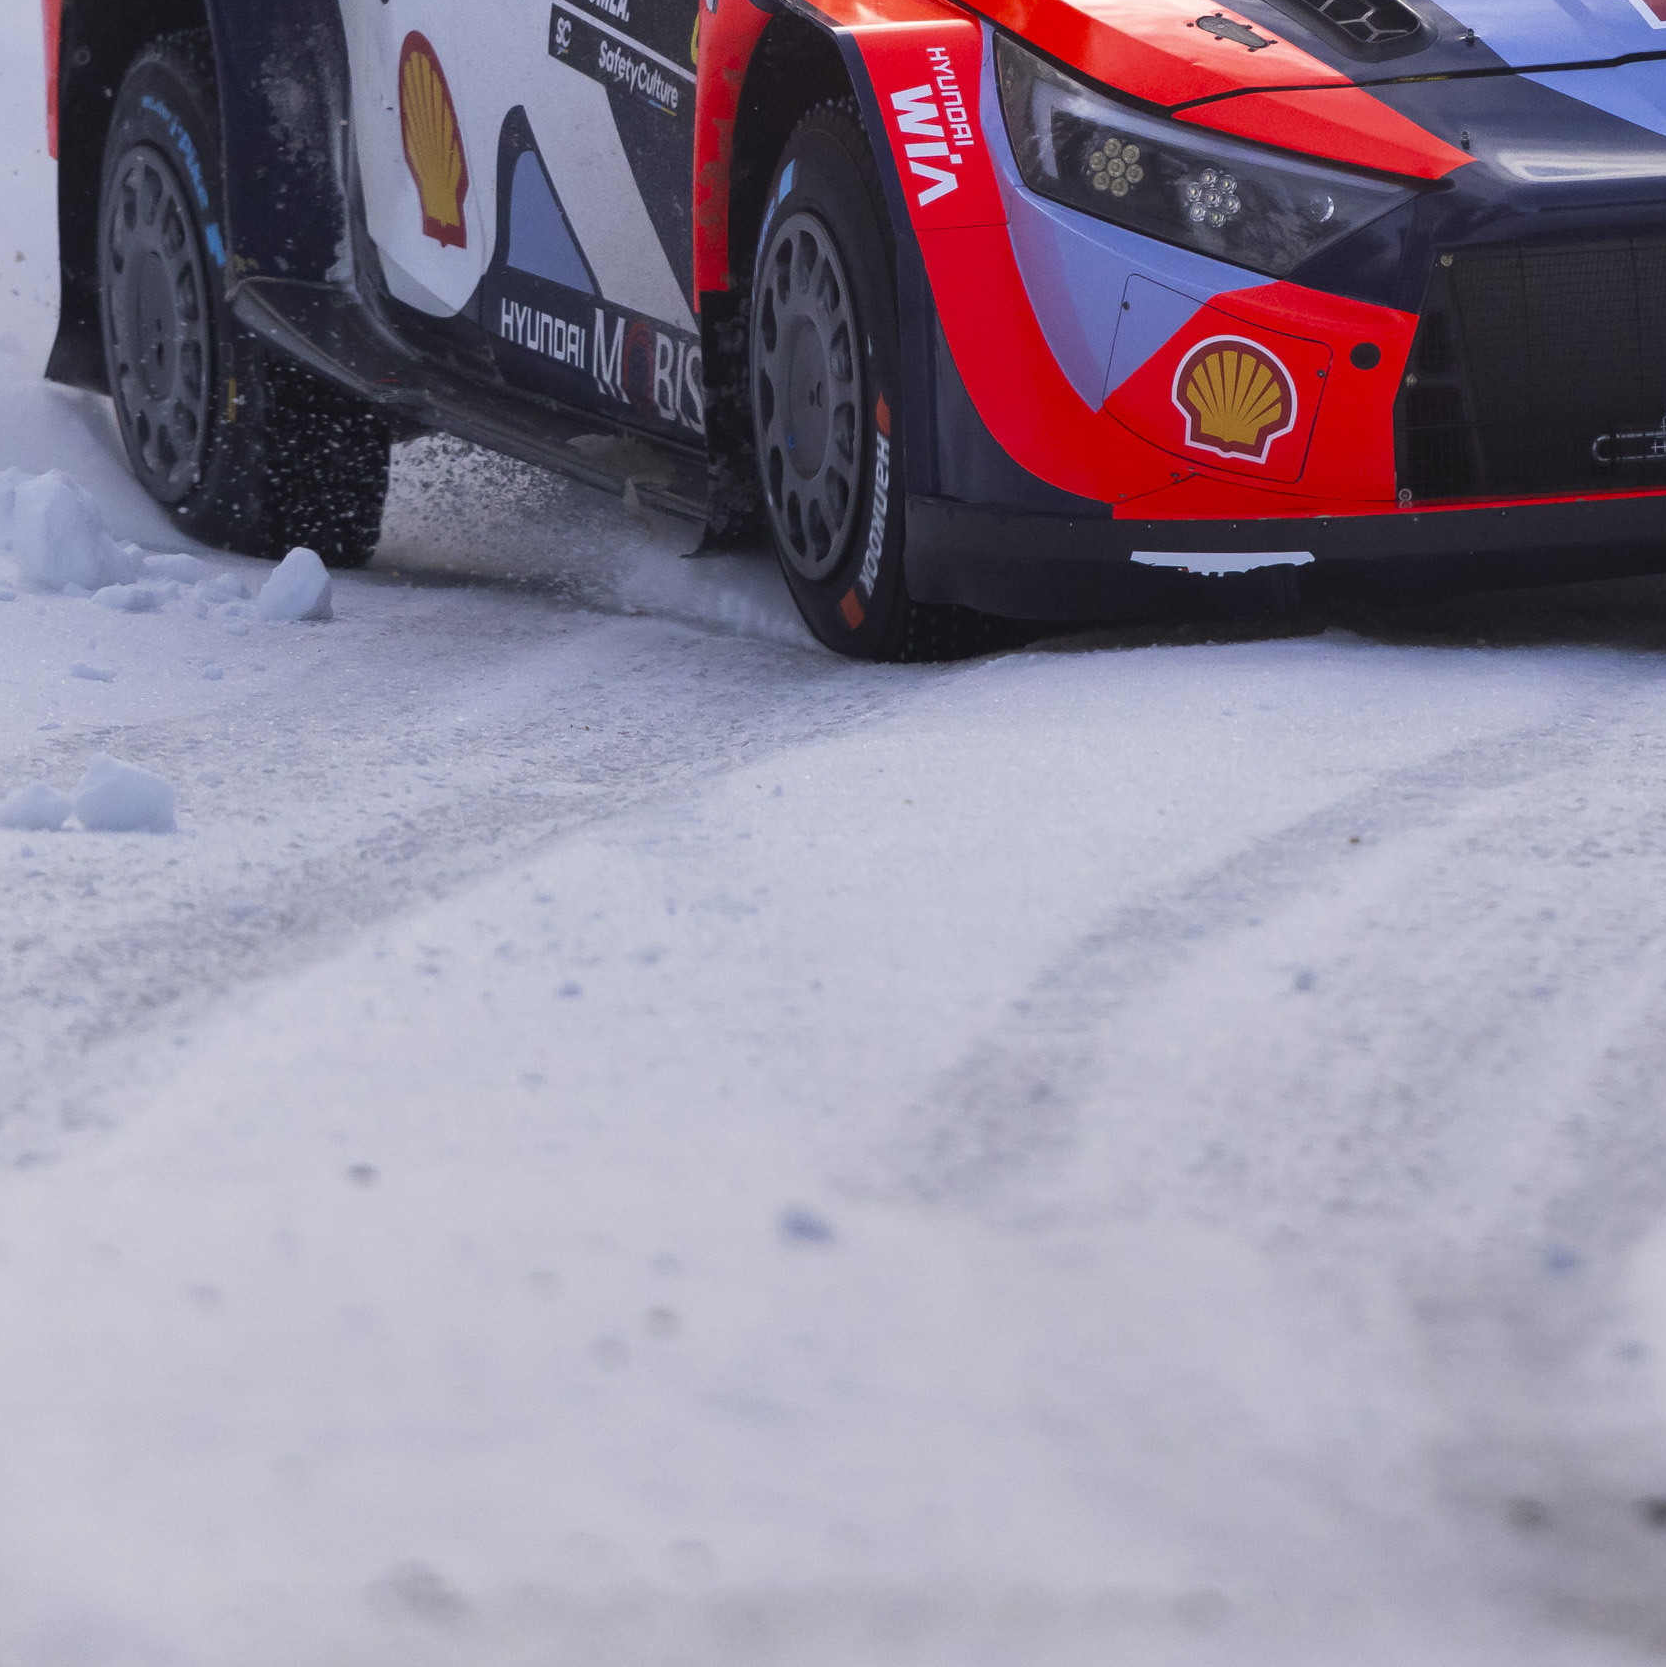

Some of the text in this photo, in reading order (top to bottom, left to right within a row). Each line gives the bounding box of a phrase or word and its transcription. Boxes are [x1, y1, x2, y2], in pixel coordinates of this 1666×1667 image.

[598, 40, 679, 109] SafetyCulture
[926, 46, 975, 146] HYUNDAI
[500, 297, 707, 436] HYUNDAI MOBIS
